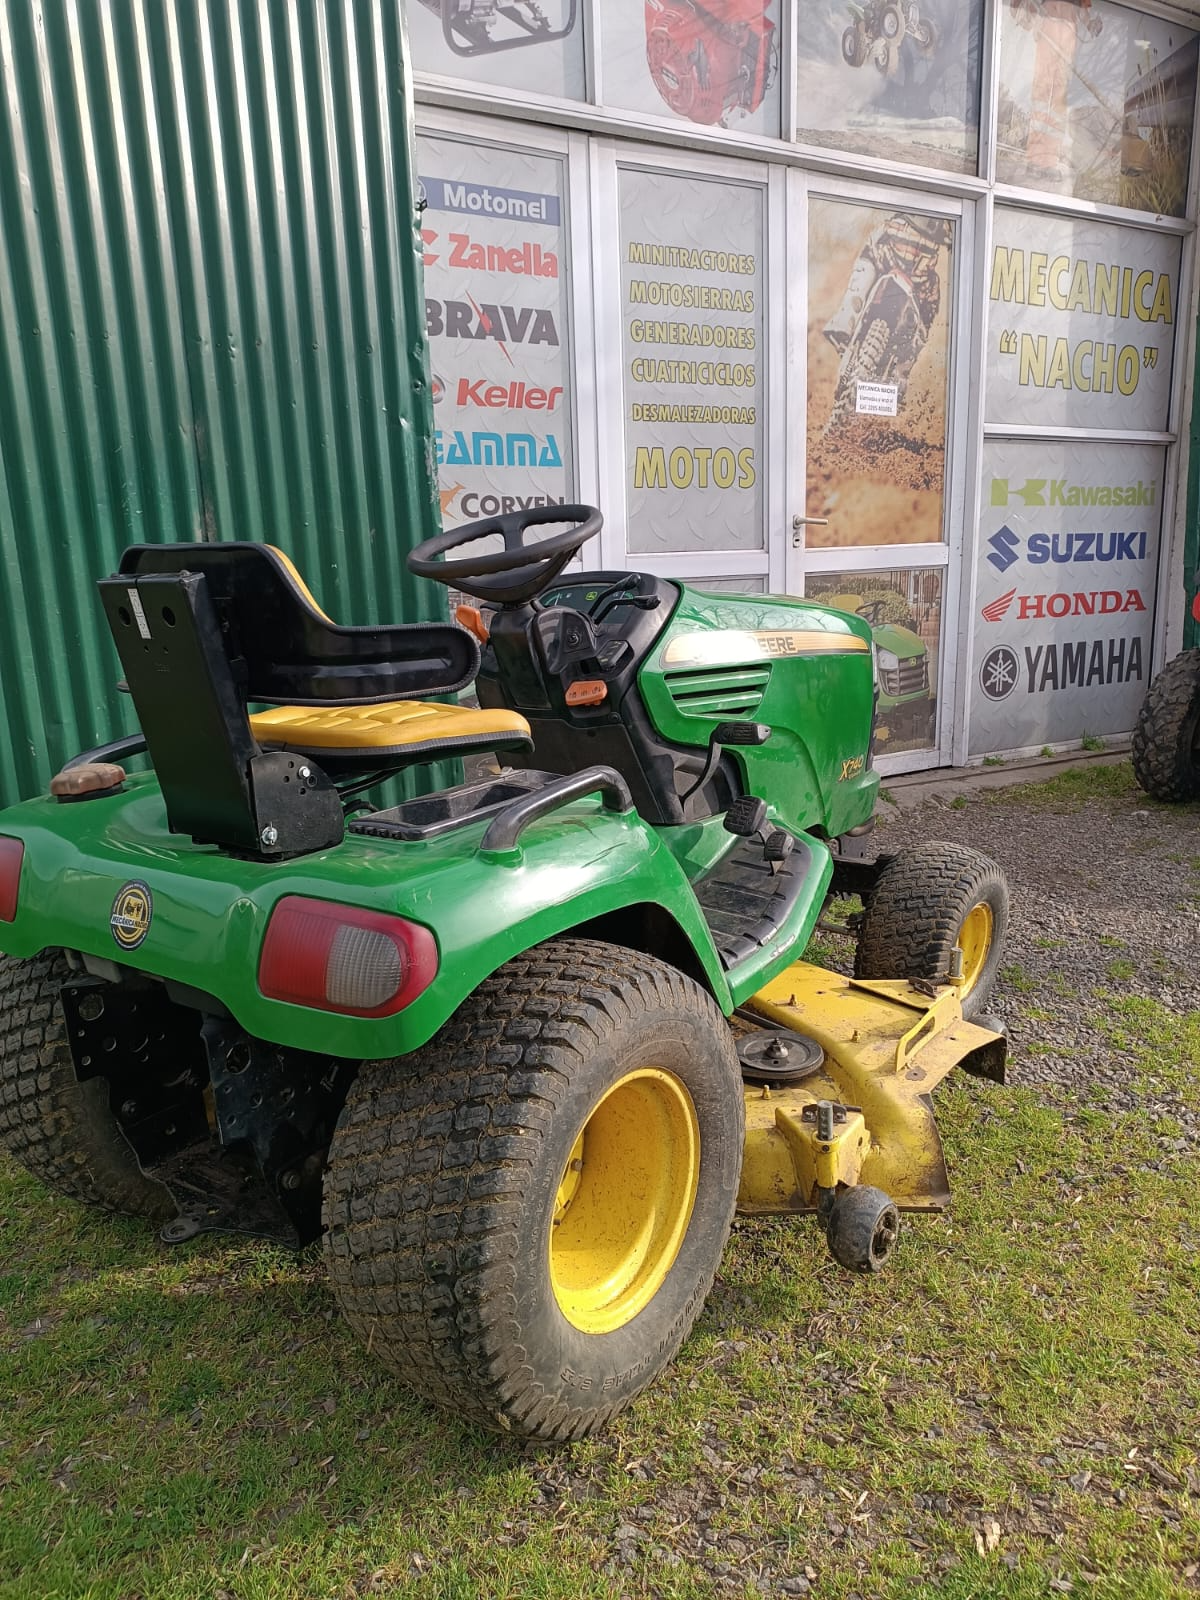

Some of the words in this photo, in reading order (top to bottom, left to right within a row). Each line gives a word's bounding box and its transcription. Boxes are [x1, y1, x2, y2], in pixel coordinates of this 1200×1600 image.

[443, 183, 547, 220] Motomel
[448, 232, 559, 279] Zanella
[628, 241, 756, 275] MINITRACTORES
[629, 279, 755, 313] MOTOSIERRAS
[989, 245, 1173, 325] MECANICA
[424, 298, 560, 347] BRAVA
[630, 318, 756, 350] GENERADORES
[631, 357, 756, 388] CUATRICICLOS
[456, 377, 564, 411] Keller
[632, 403, 757, 425] DESMALEZADORAS
[634, 446, 757, 490] MOTOS
[1050, 479, 1157, 507] Kawasaki
[1027, 532, 1148, 564] SUZUKI
[1016, 589, 1147, 620] HONDA
[757, 637, 796, 653] EERE
[1024, 636, 1143, 694] YAMAHA
